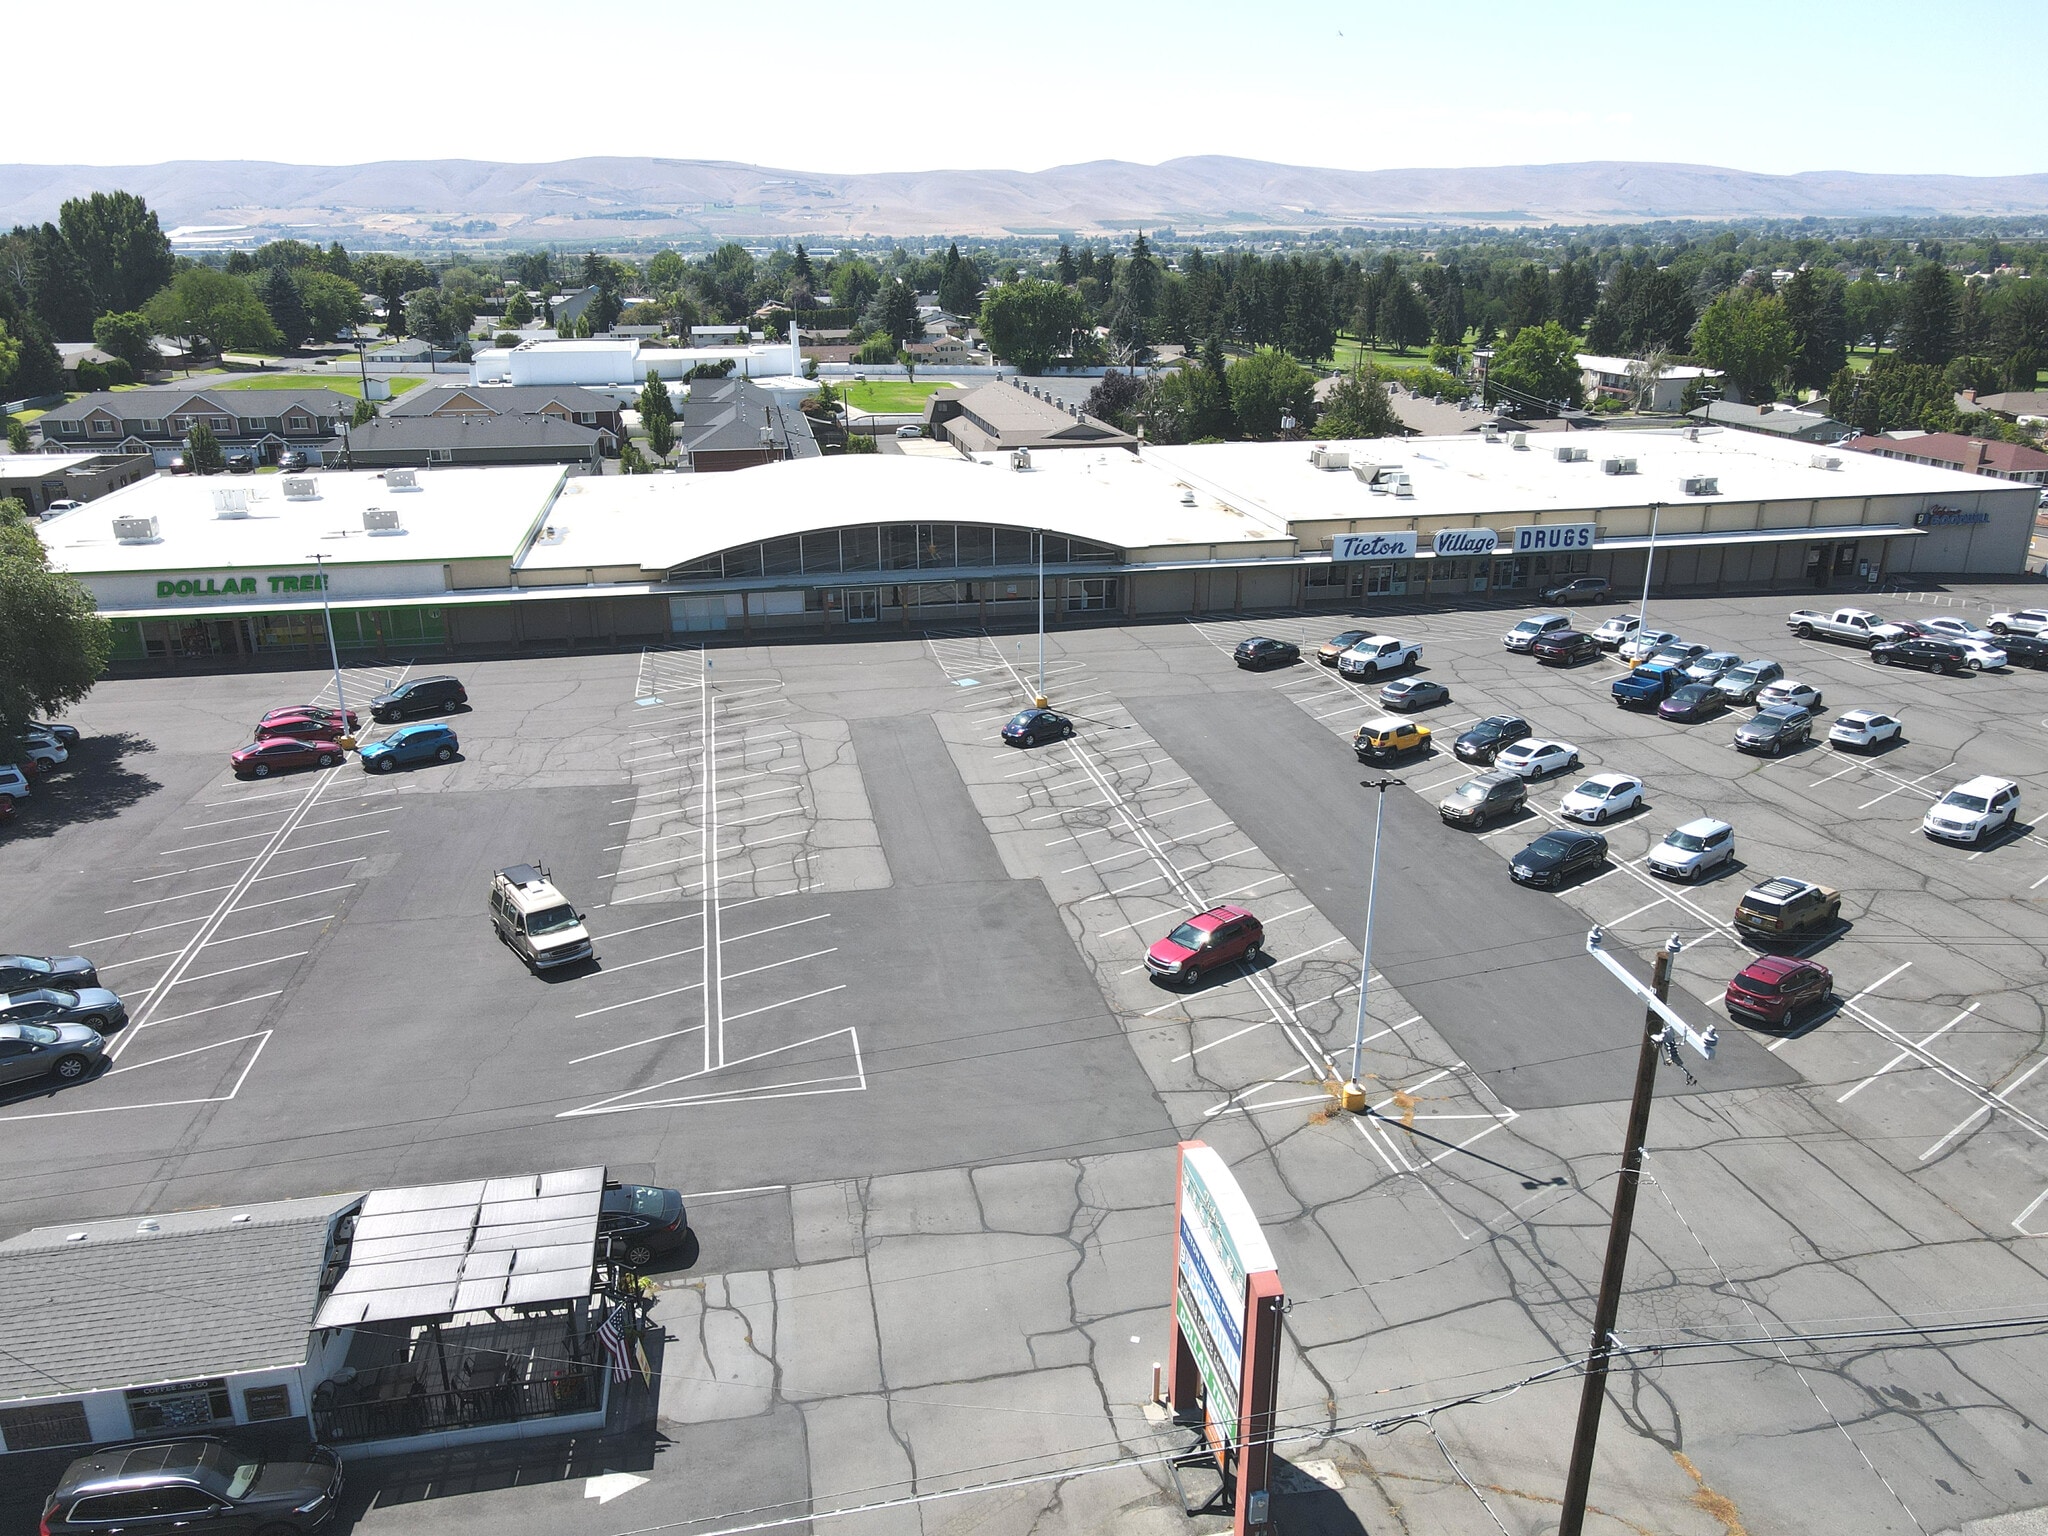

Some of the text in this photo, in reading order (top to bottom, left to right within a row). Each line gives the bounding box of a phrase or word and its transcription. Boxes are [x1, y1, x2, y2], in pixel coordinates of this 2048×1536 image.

[1931, 513, 1990, 526] GOODWILL
[1343, 528, 1590, 557] Tieton Village DRUGS
[157, 574, 329, 598] DOLLAR TREE
[1200, 1257, 1221, 1306] VILLAGE
[1221, 1302, 1240, 1345] DRUGS
[1189, 1267, 1239, 1387] GOODWILL
[1198, 1315, 1214, 1355] coffee
[1180, 1306, 1209, 1380] DOLLAR
[1212, 1378, 1232, 1434] TREE
[144, 1385, 177, 1394] COFFEE
